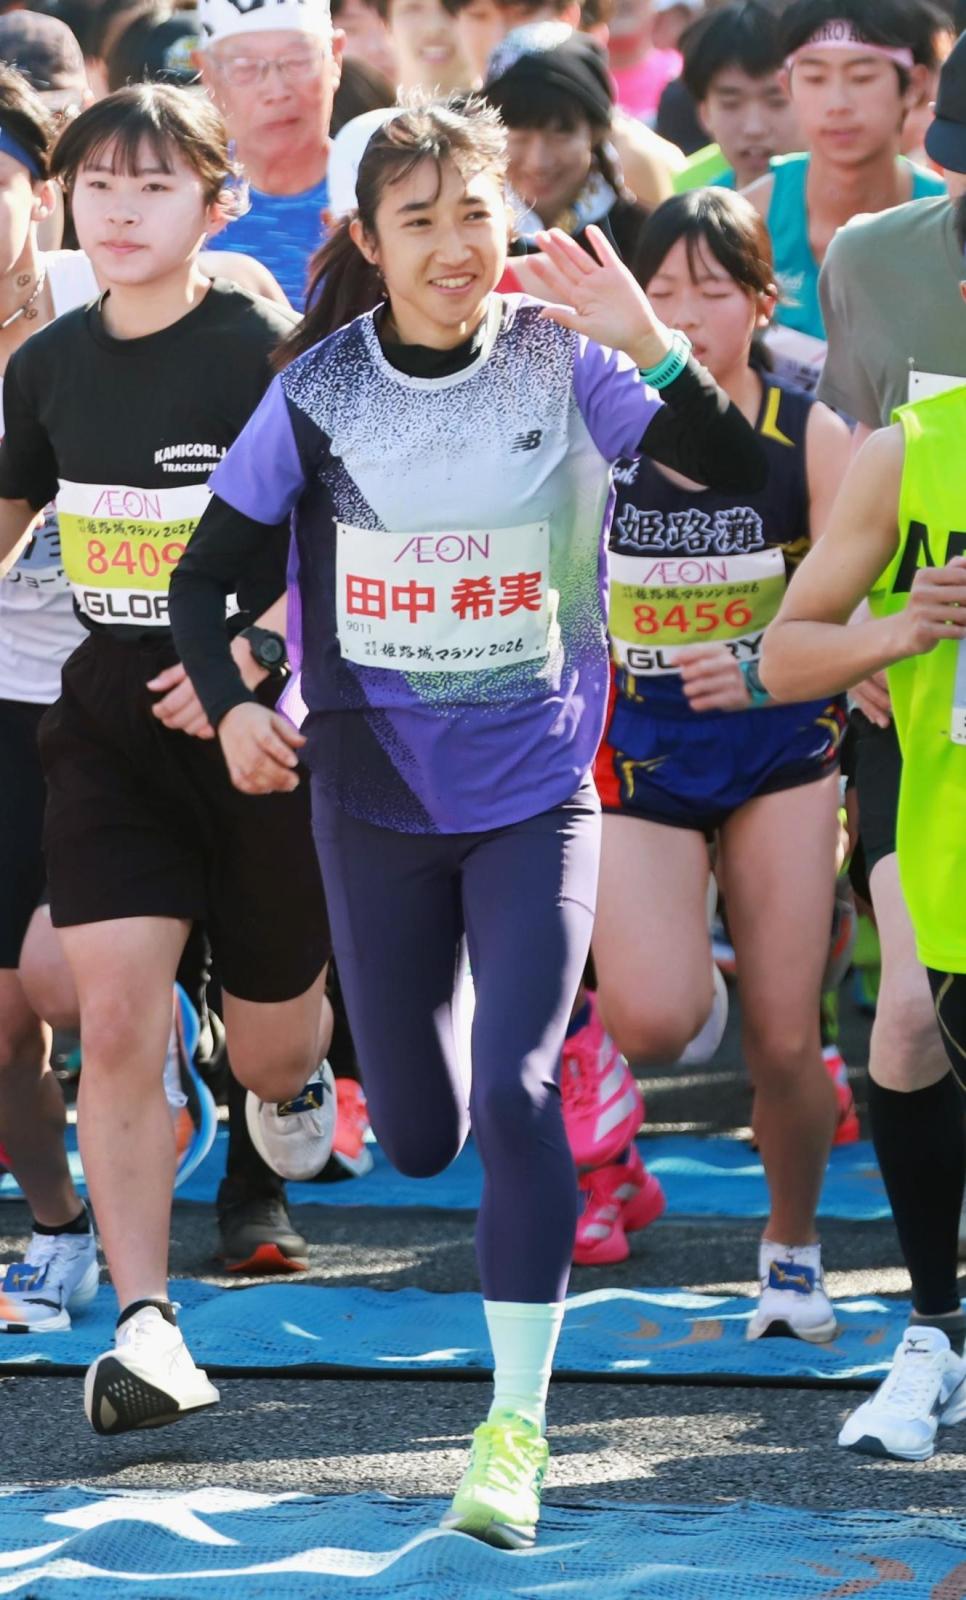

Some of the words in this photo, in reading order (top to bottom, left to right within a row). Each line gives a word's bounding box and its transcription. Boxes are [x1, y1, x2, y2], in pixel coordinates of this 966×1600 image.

[617, 503, 765, 554] 姫路灘
[346, 573, 435, 624] 田中
[451, 571, 543, 621] 希実
[633, 598, 753, 635] 8456
[346, 620, 373, 635] 9011
